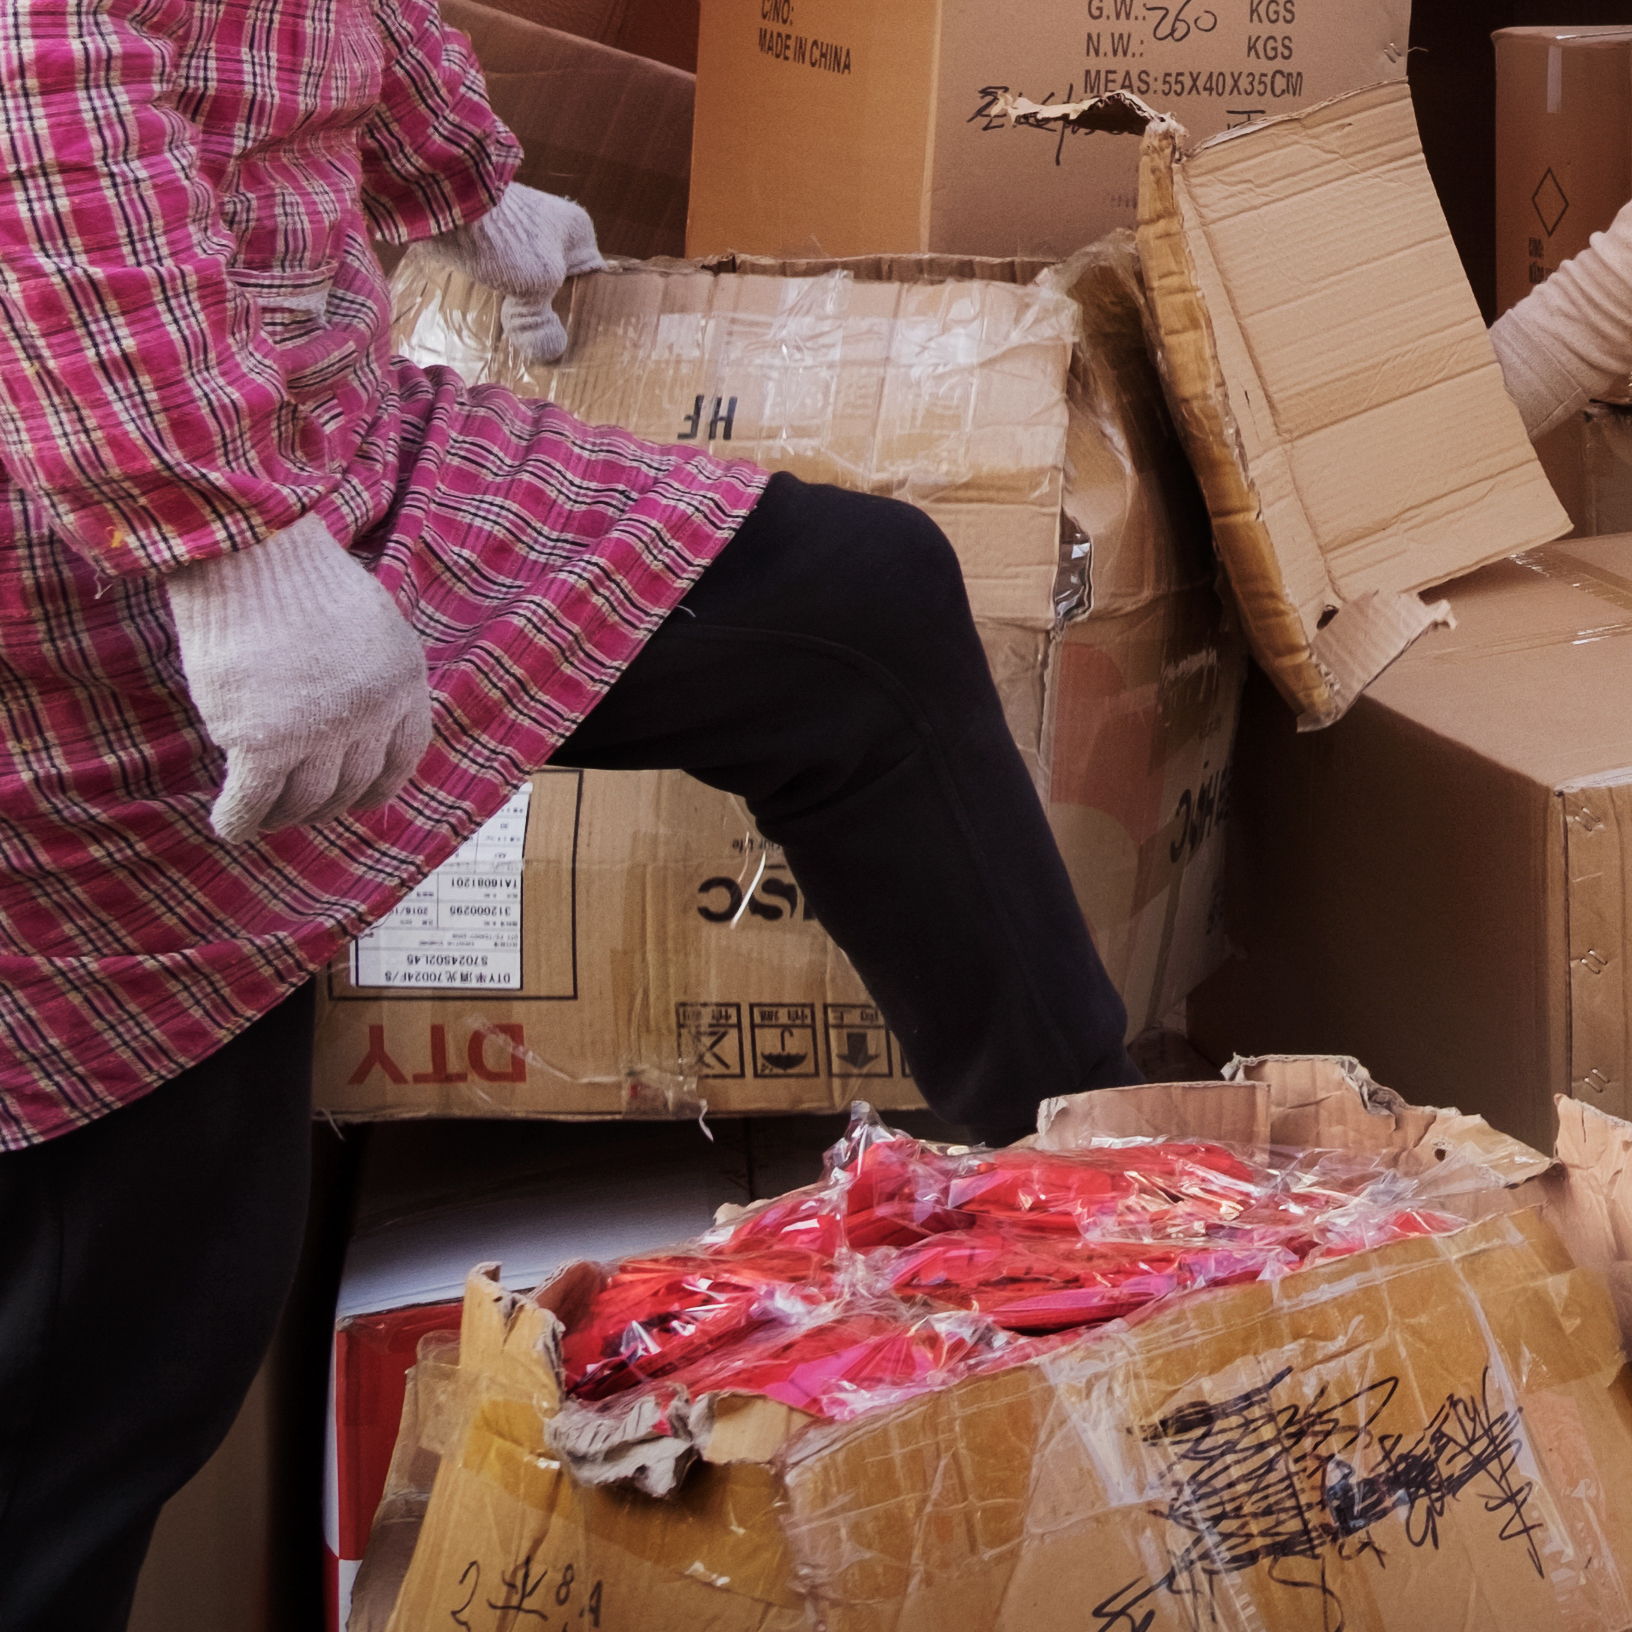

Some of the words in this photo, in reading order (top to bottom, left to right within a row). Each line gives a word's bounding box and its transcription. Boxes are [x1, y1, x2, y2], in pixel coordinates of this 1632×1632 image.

[758, 27, 792, 61] MADE
[794, 34, 808, 65] IN
[809, 39, 852, 75] CHINA
[1246, 34, 1294, 61] KGS
[348, 1023, 527, 1084] DTY
